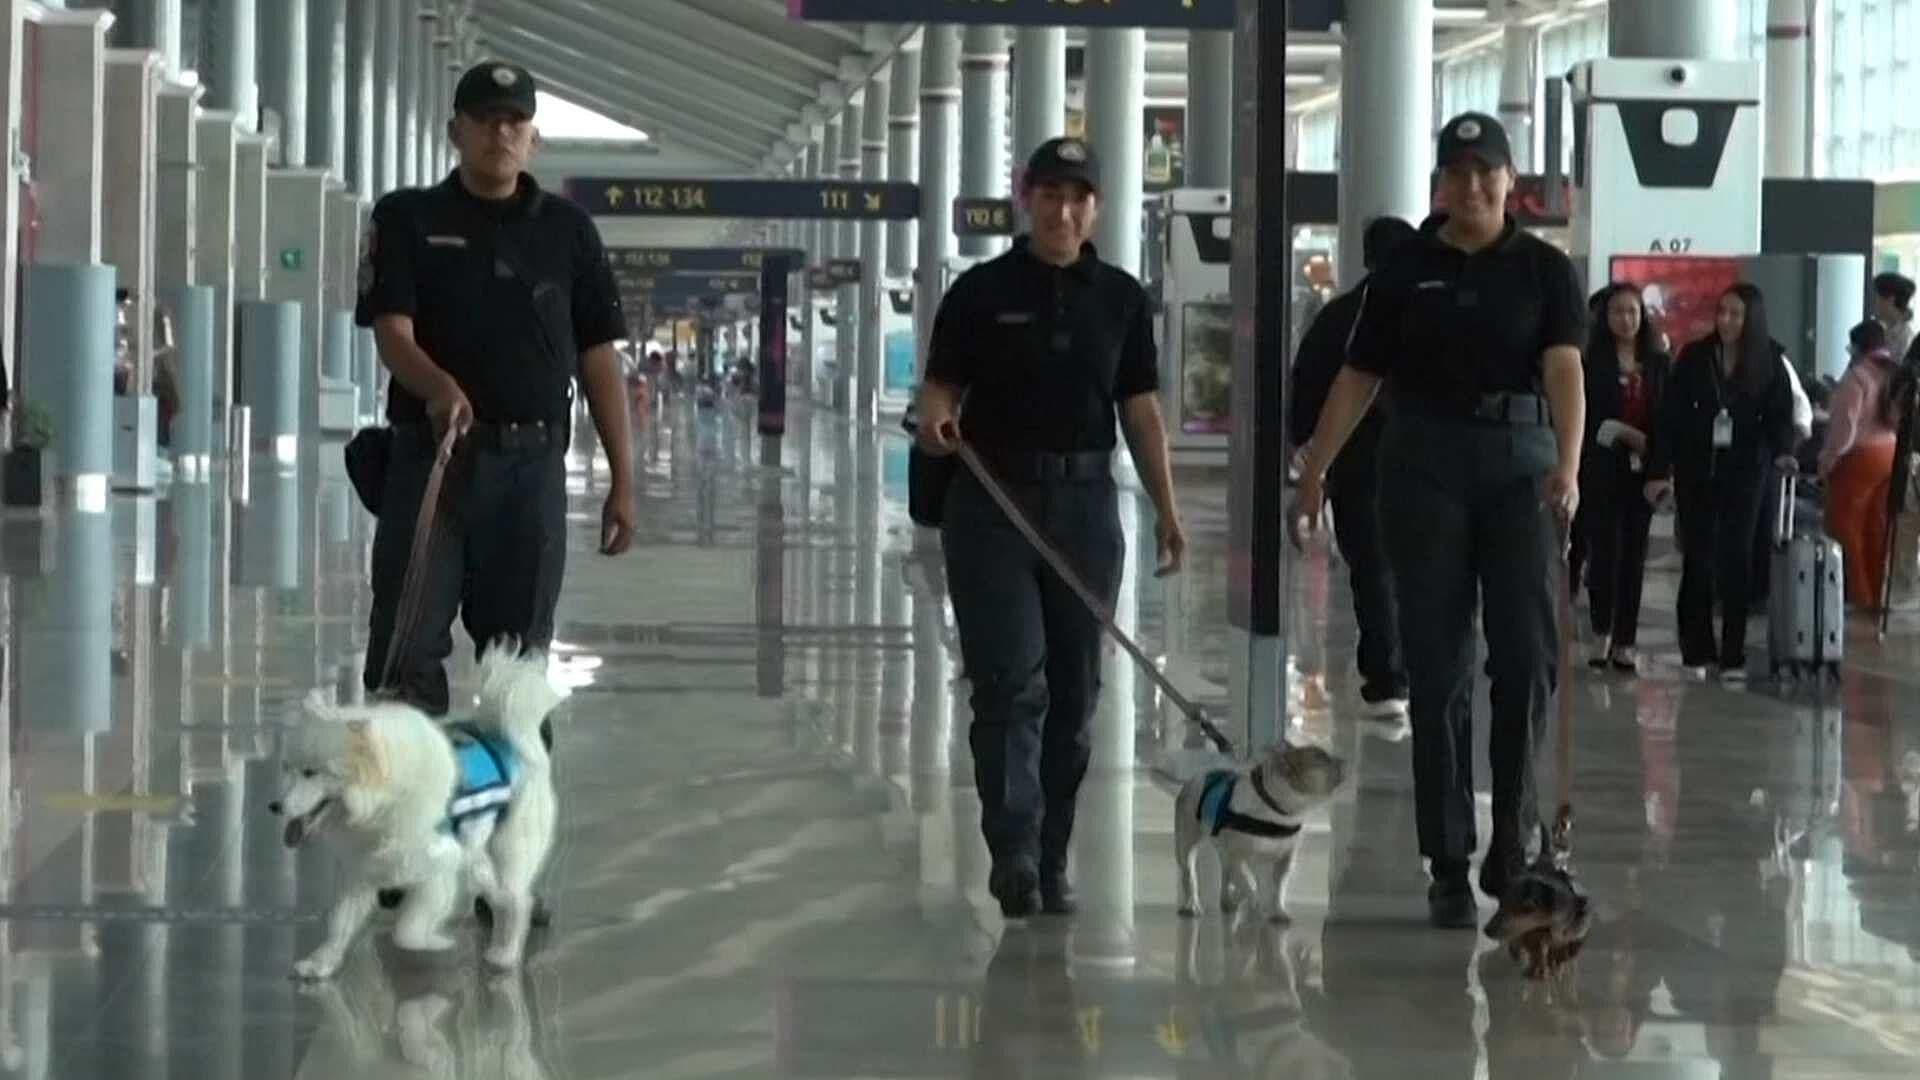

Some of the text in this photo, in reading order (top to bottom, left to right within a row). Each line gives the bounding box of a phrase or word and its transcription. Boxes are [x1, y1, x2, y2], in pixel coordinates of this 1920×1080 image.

[634, 187, 664, 208] 112
[820, 191, 849, 210] 111
[1650, 238, 1692, 253] A 07
